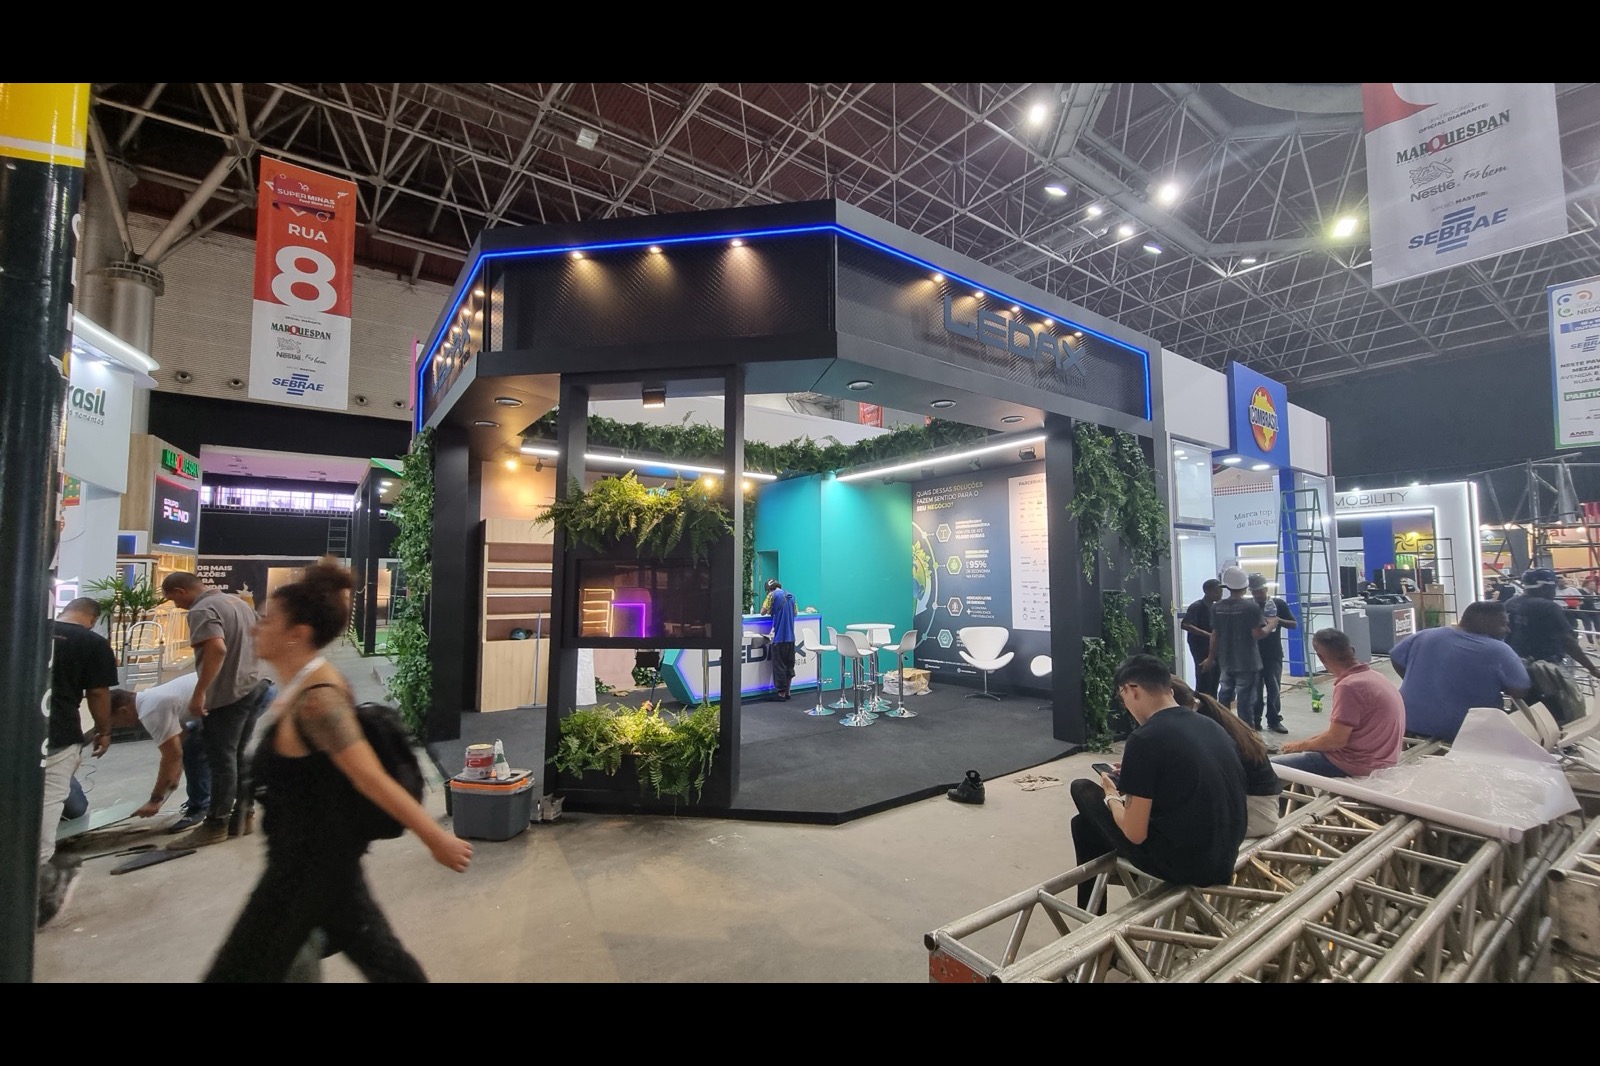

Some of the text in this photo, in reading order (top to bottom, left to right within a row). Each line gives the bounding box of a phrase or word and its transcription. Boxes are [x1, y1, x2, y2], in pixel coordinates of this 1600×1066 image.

[1418, 120, 1446, 134] OFICIAL
[1396, 109, 1511, 164] MARQUESPAN
[288, 223, 328, 243] RUA
[1408, 208, 1509, 250] SEBRAE
[271, 246, 338, 313] 8
[270, 322, 332, 341] MARQUESPAN
[943, 294, 1086, 378] LEDAX
[271, 377, 325, 392] SEBRAE
[1250, 405, 1279, 432] COMBRASIL
[916, 481, 984, 497] QUAIS DESSAS SOLUÇÕES
[163, 498, 180, 508] GRUPO
[916, 496, 934, 504] FAZEM
[934, 493, 957, 502] SENTIDO
[957, 491, 973, 499] PARA
[163, 506, 190, 524] PLENO
[916, 504, 927, 512] SEU
[1234, 509, 1273, 521] Marca top
[1236, 521, 1246, 529] de
[1247, 519, 1262, 527] alta
[969, 560, 987, 569] 95%
